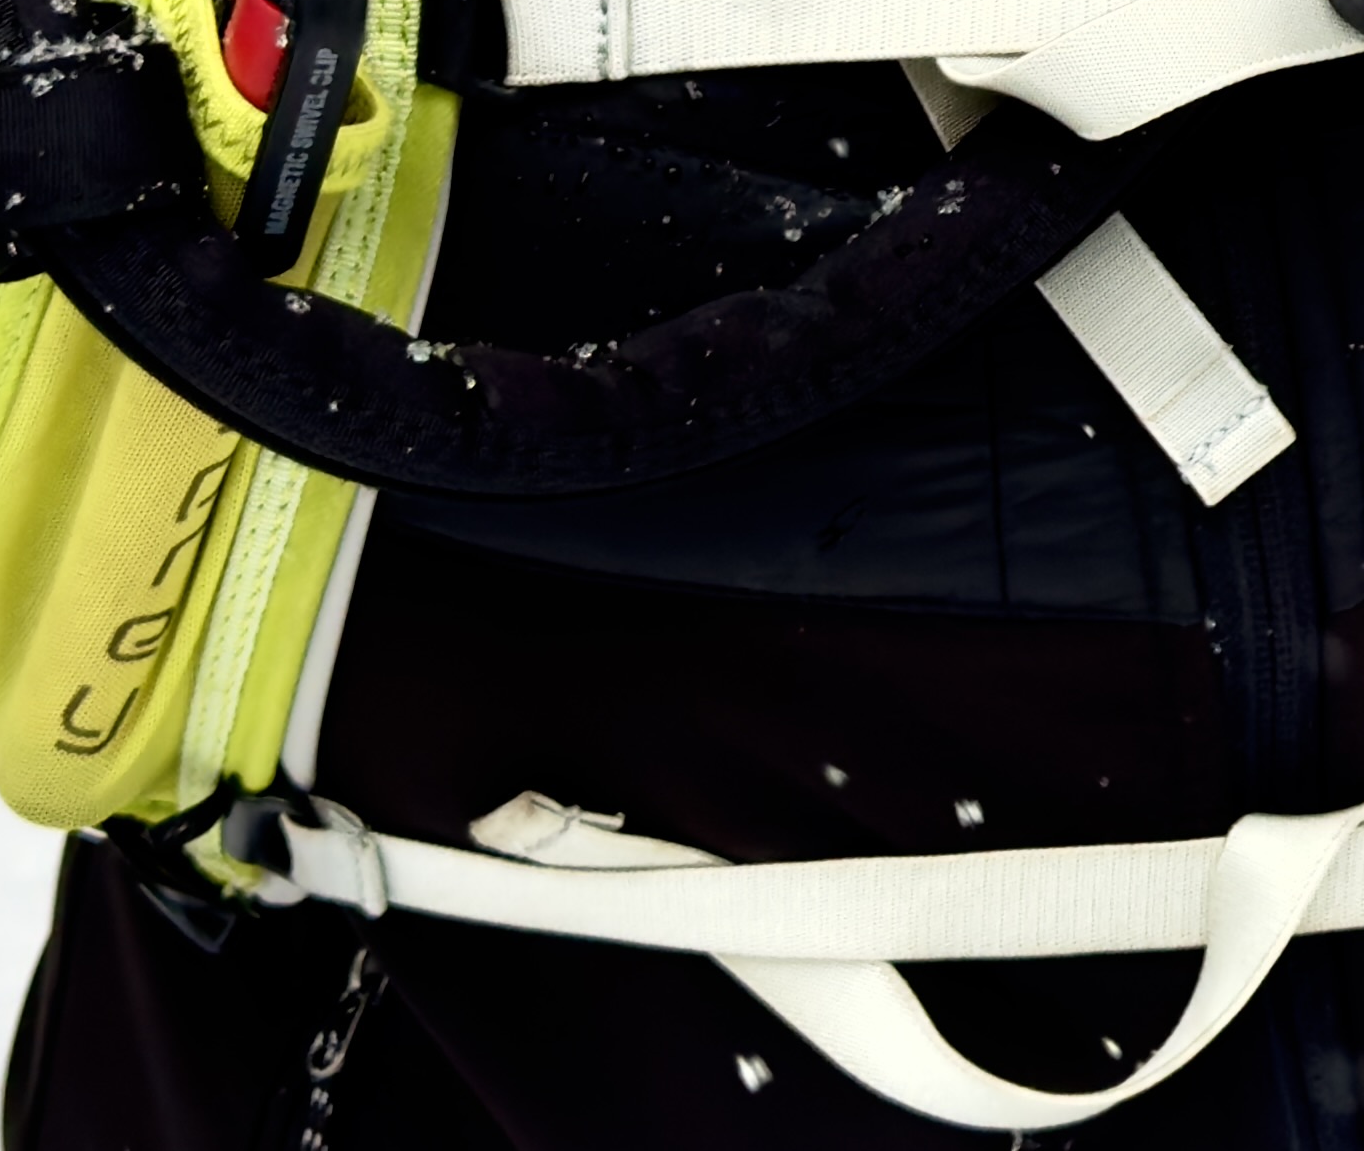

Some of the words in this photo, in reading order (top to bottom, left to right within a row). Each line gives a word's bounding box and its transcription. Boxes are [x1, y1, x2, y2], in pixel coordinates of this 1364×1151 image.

[308, 47, 340, 87] CLIP
[289, 89, 331, 150] SWIVEL
[263, 152, 312, 235] MAGNETIC
